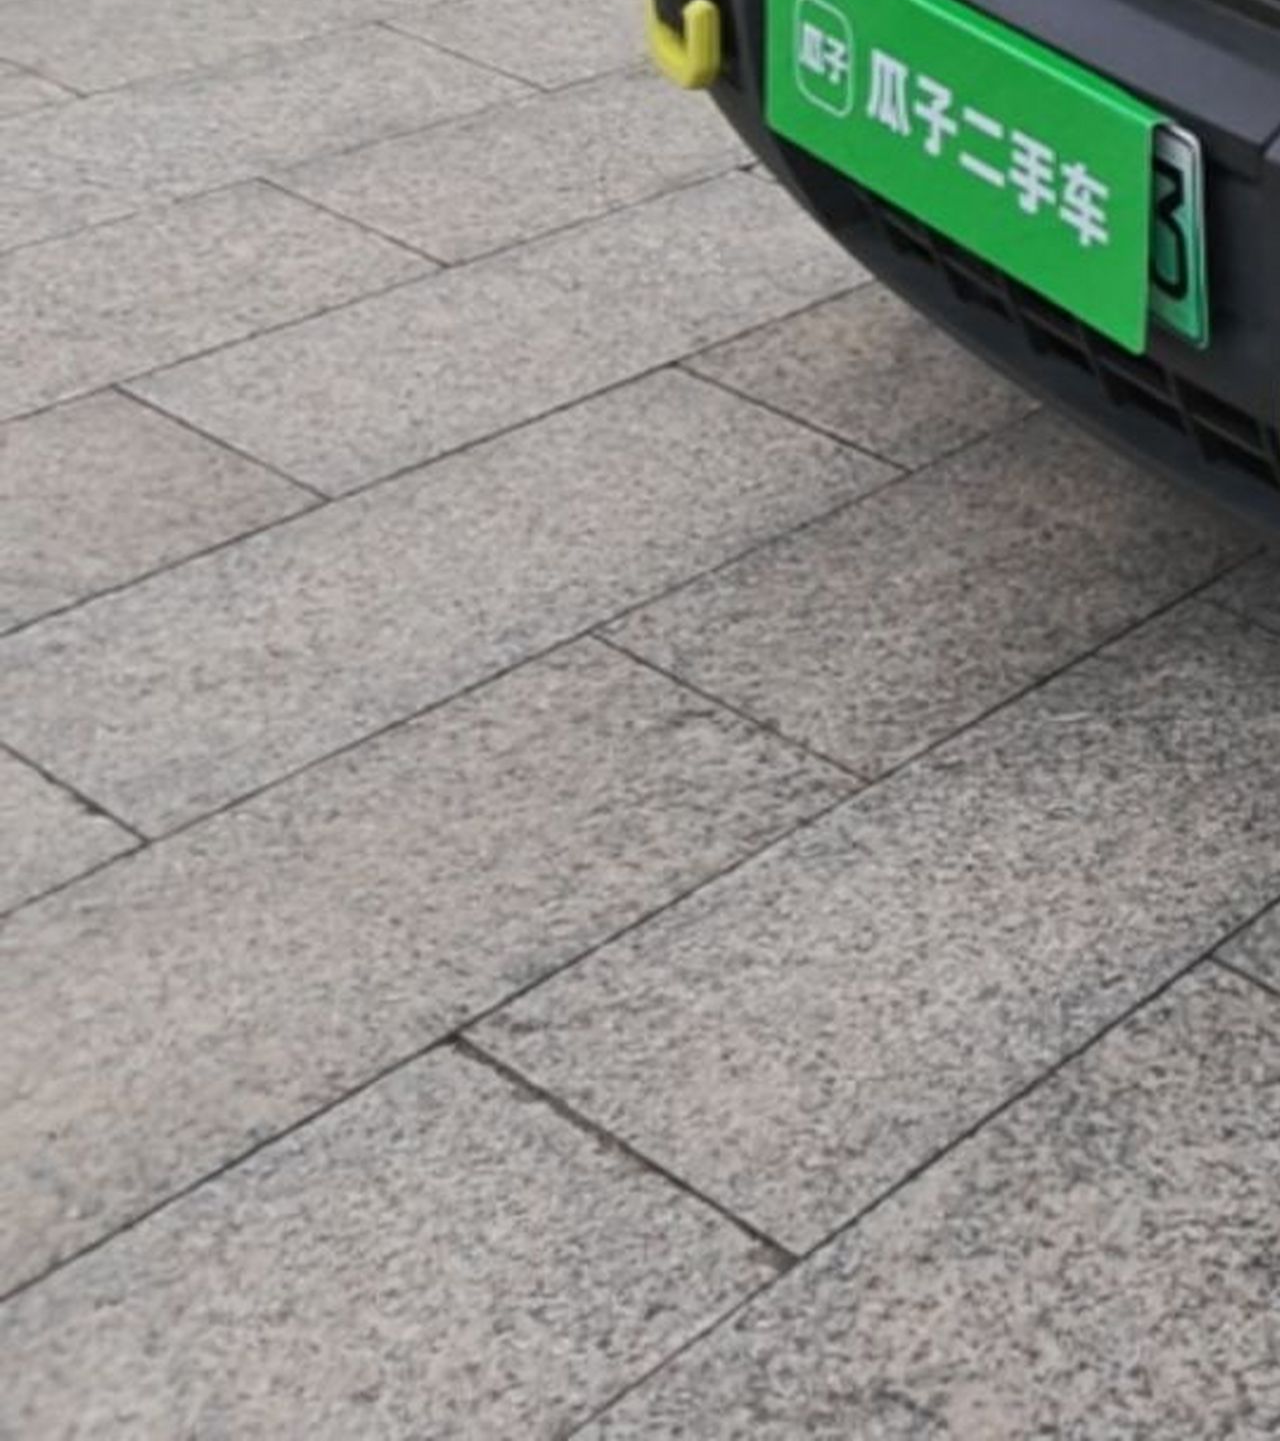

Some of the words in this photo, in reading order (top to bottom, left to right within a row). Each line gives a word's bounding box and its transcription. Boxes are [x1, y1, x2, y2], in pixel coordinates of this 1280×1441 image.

[801, 23, 848, 86] 瓜子
[866, 48, 1110, 247] 瓜子二手车
